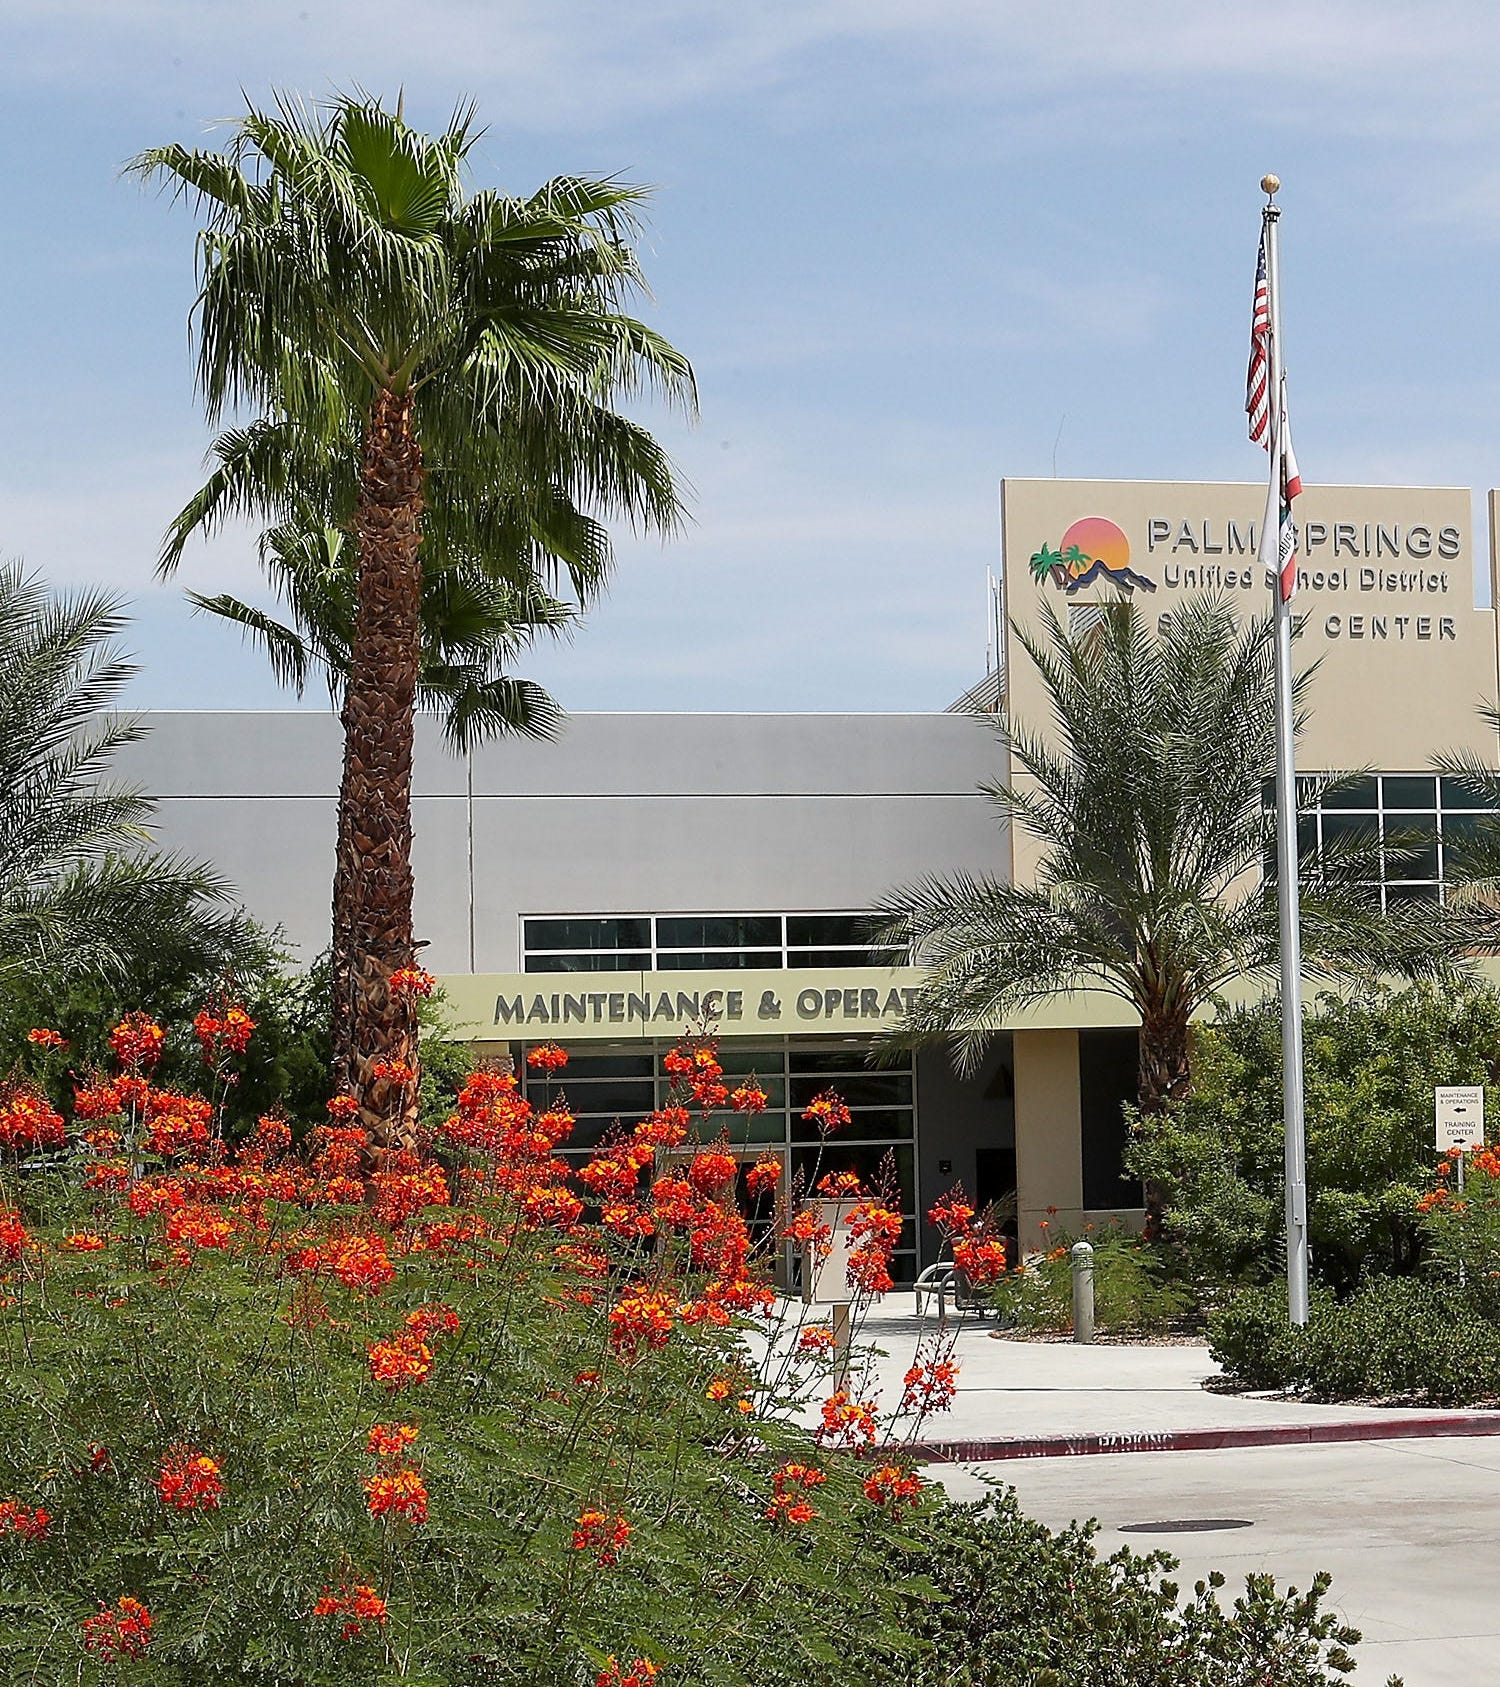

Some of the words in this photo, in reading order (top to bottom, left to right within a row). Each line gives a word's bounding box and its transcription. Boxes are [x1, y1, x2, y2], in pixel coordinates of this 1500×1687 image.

[1148, 517, 1257, 555] PALM
[1164, 562, 1253, 589] Unified
[1264, 566, 1348, 591] Shool
[1360, 568, 1449, 593] District
[1325, 614, 1457, 641] CENTER
[493, 990, 744, 1025] MAINTENANCE
[757, 990, 782, 1020] &
[796, 987, 922, 1020] OPERAT
